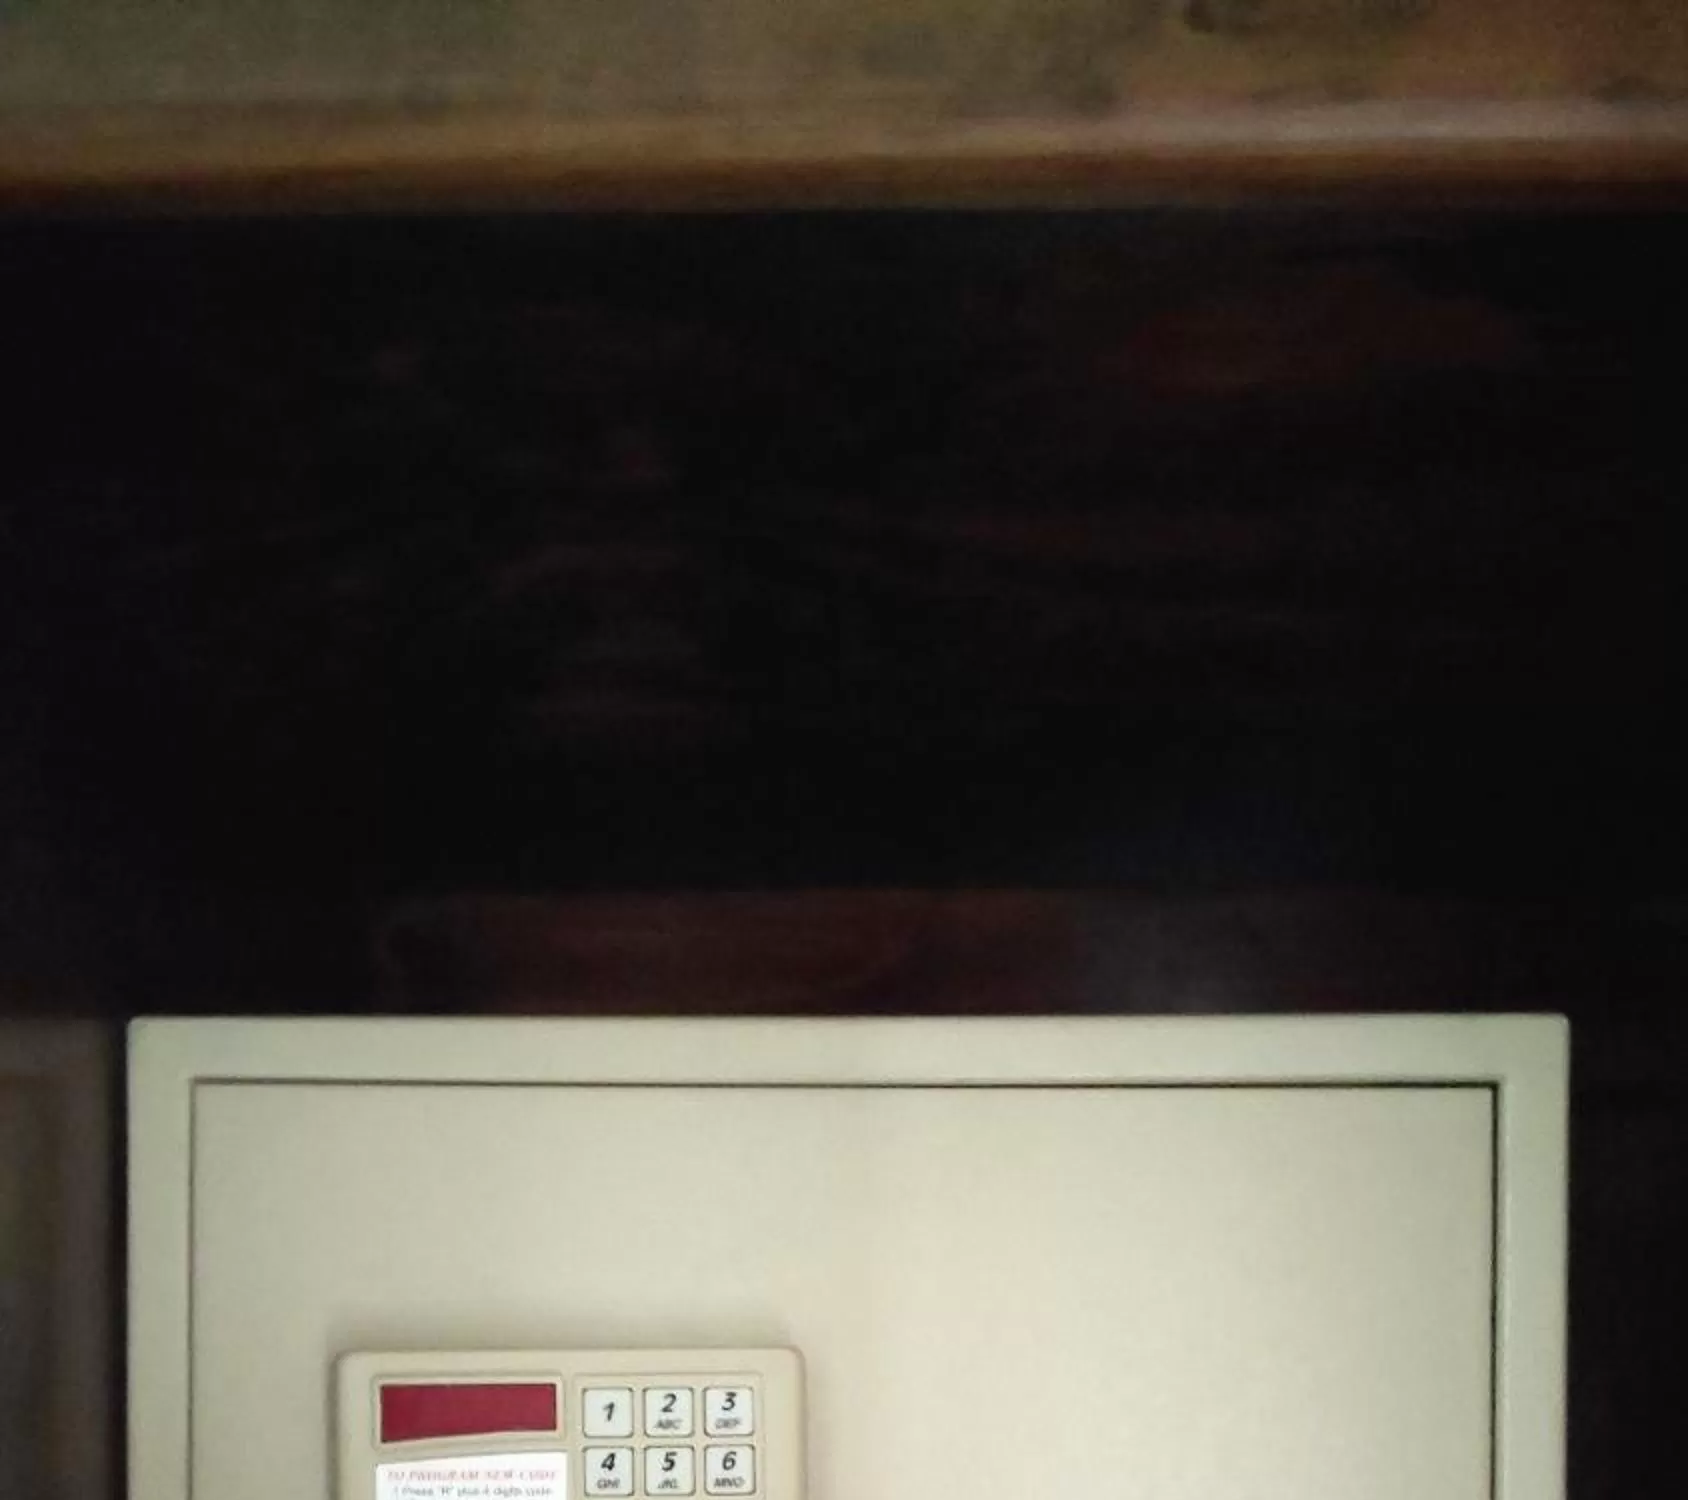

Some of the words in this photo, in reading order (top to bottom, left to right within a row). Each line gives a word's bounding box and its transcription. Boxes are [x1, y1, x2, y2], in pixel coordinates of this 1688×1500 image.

[661, 1393, 677, 1413] 2
[722, 1391, 737, 1411] 3
[604, 1401, 615, 1422] 1
[655, 1419, 682, 1431] ABC
[715, 1419, 741, 1430] DEF
[600, 1452, 616, 1472] 4
[662, 1452, 677, 1472] 5
[722, 1451, 737, 1471] 6
[713, 1478, 745, 1488] MNO
